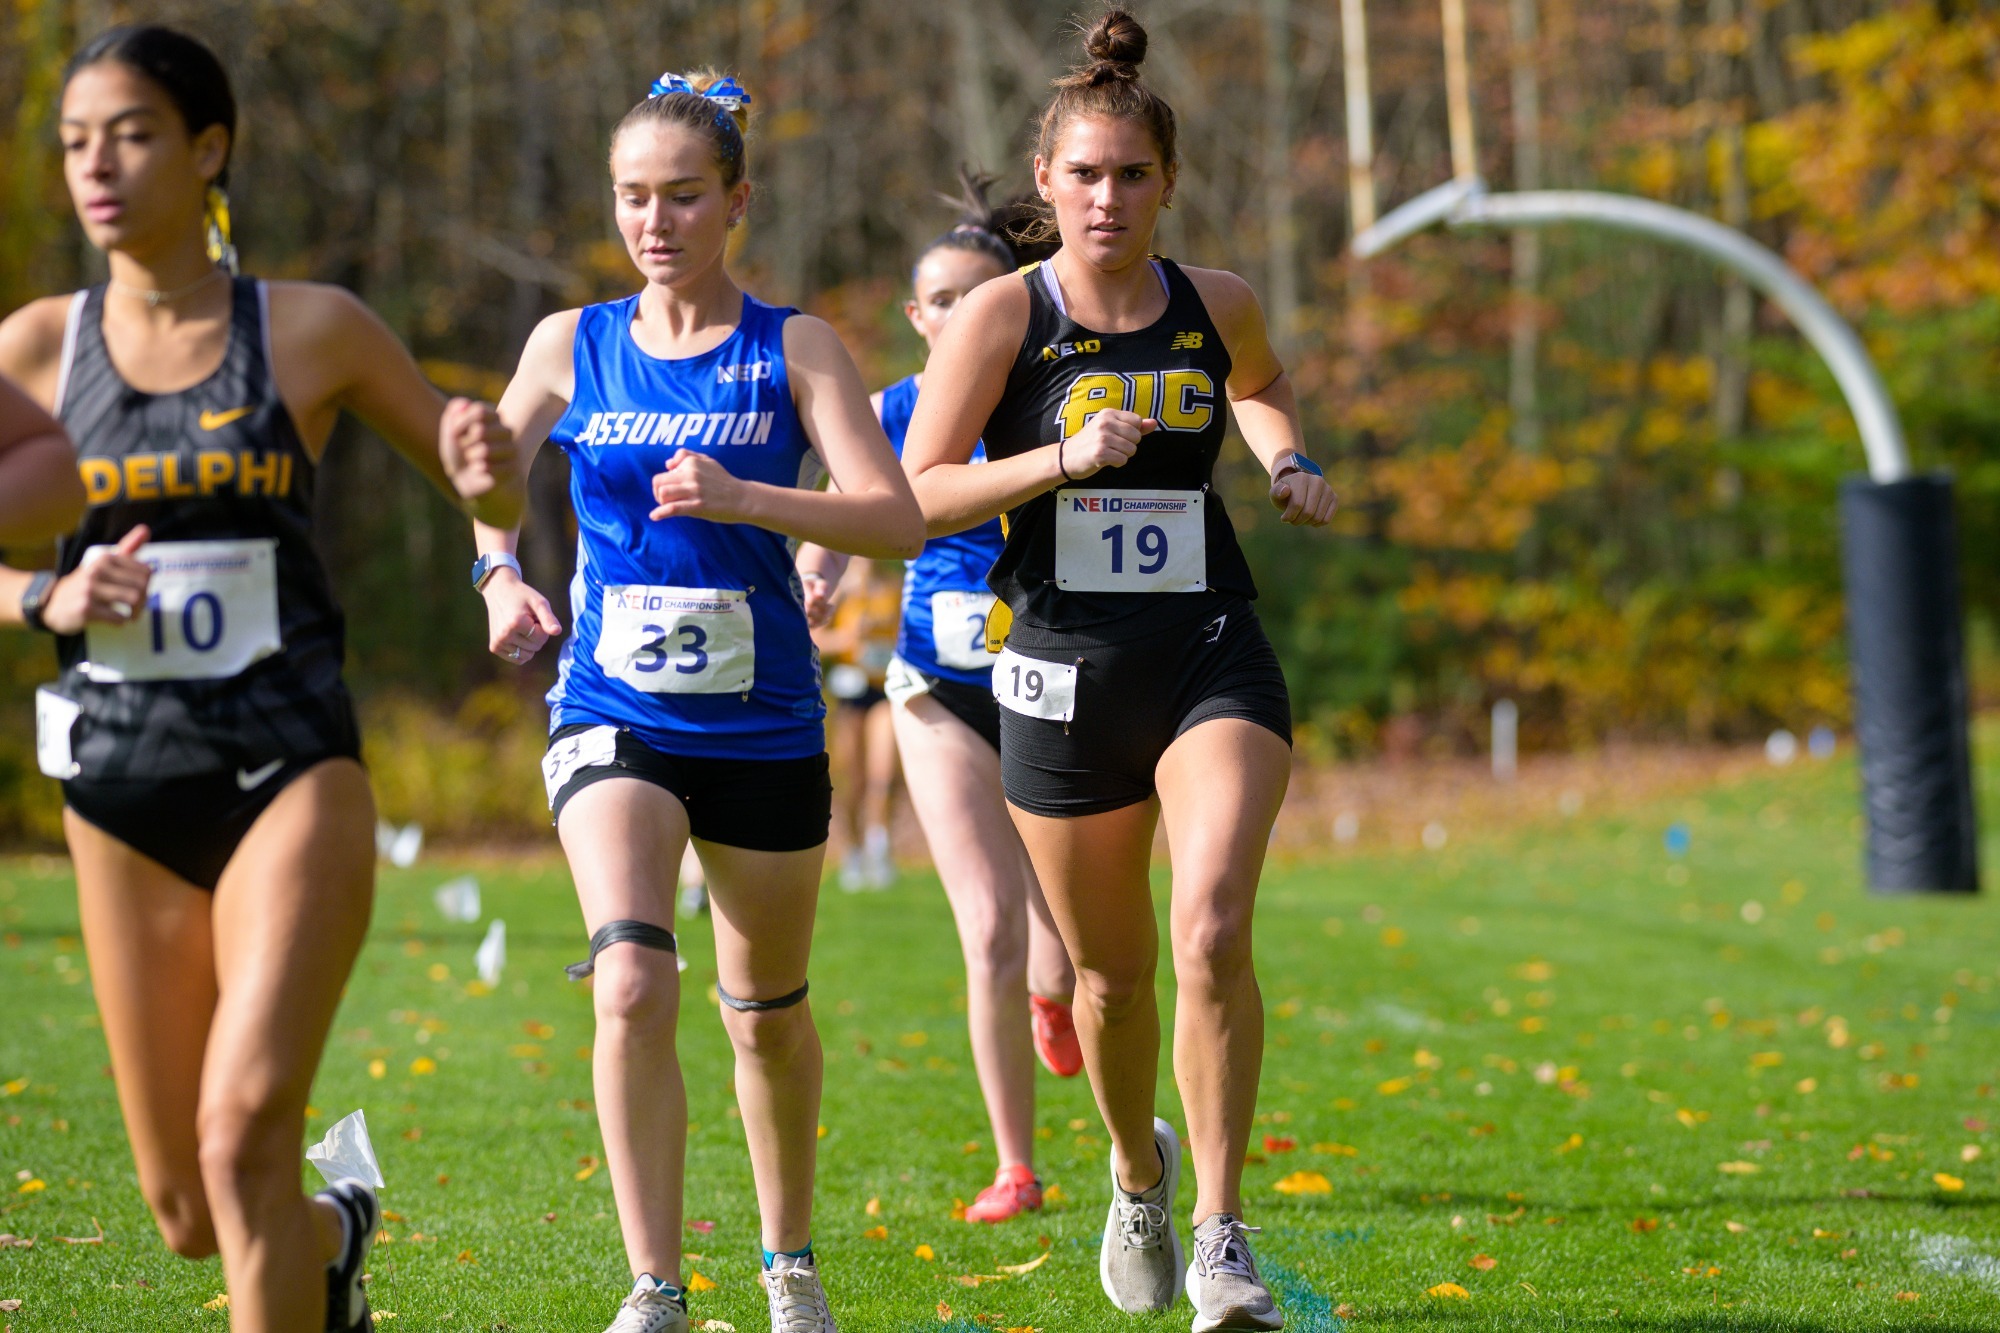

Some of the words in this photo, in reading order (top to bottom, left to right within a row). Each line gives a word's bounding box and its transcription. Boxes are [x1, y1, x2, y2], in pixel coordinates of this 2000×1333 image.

[1043, 339, 1101, 361] NE10
[717, 360, 771, 384] NE10
[1054, 369, 1214, 443] AIC
[574, 411, 775, 446] ASSUMPTION
[78, 449, 293, 506] DELPHI
[1073, 497, 1123, 512] NE10
[1123, 500, 1187, 511] CHAMPIONSHIP
[1102, 524, 1168, 575] 19
[147, 590, 223, 654] 10
[617, 593, 663, 611] NE10
[664, 599, 732, 612] CHAMPIONSHIP
[635, 624, 709, 675] 33
[1010, 664, 1044, 703] 19
